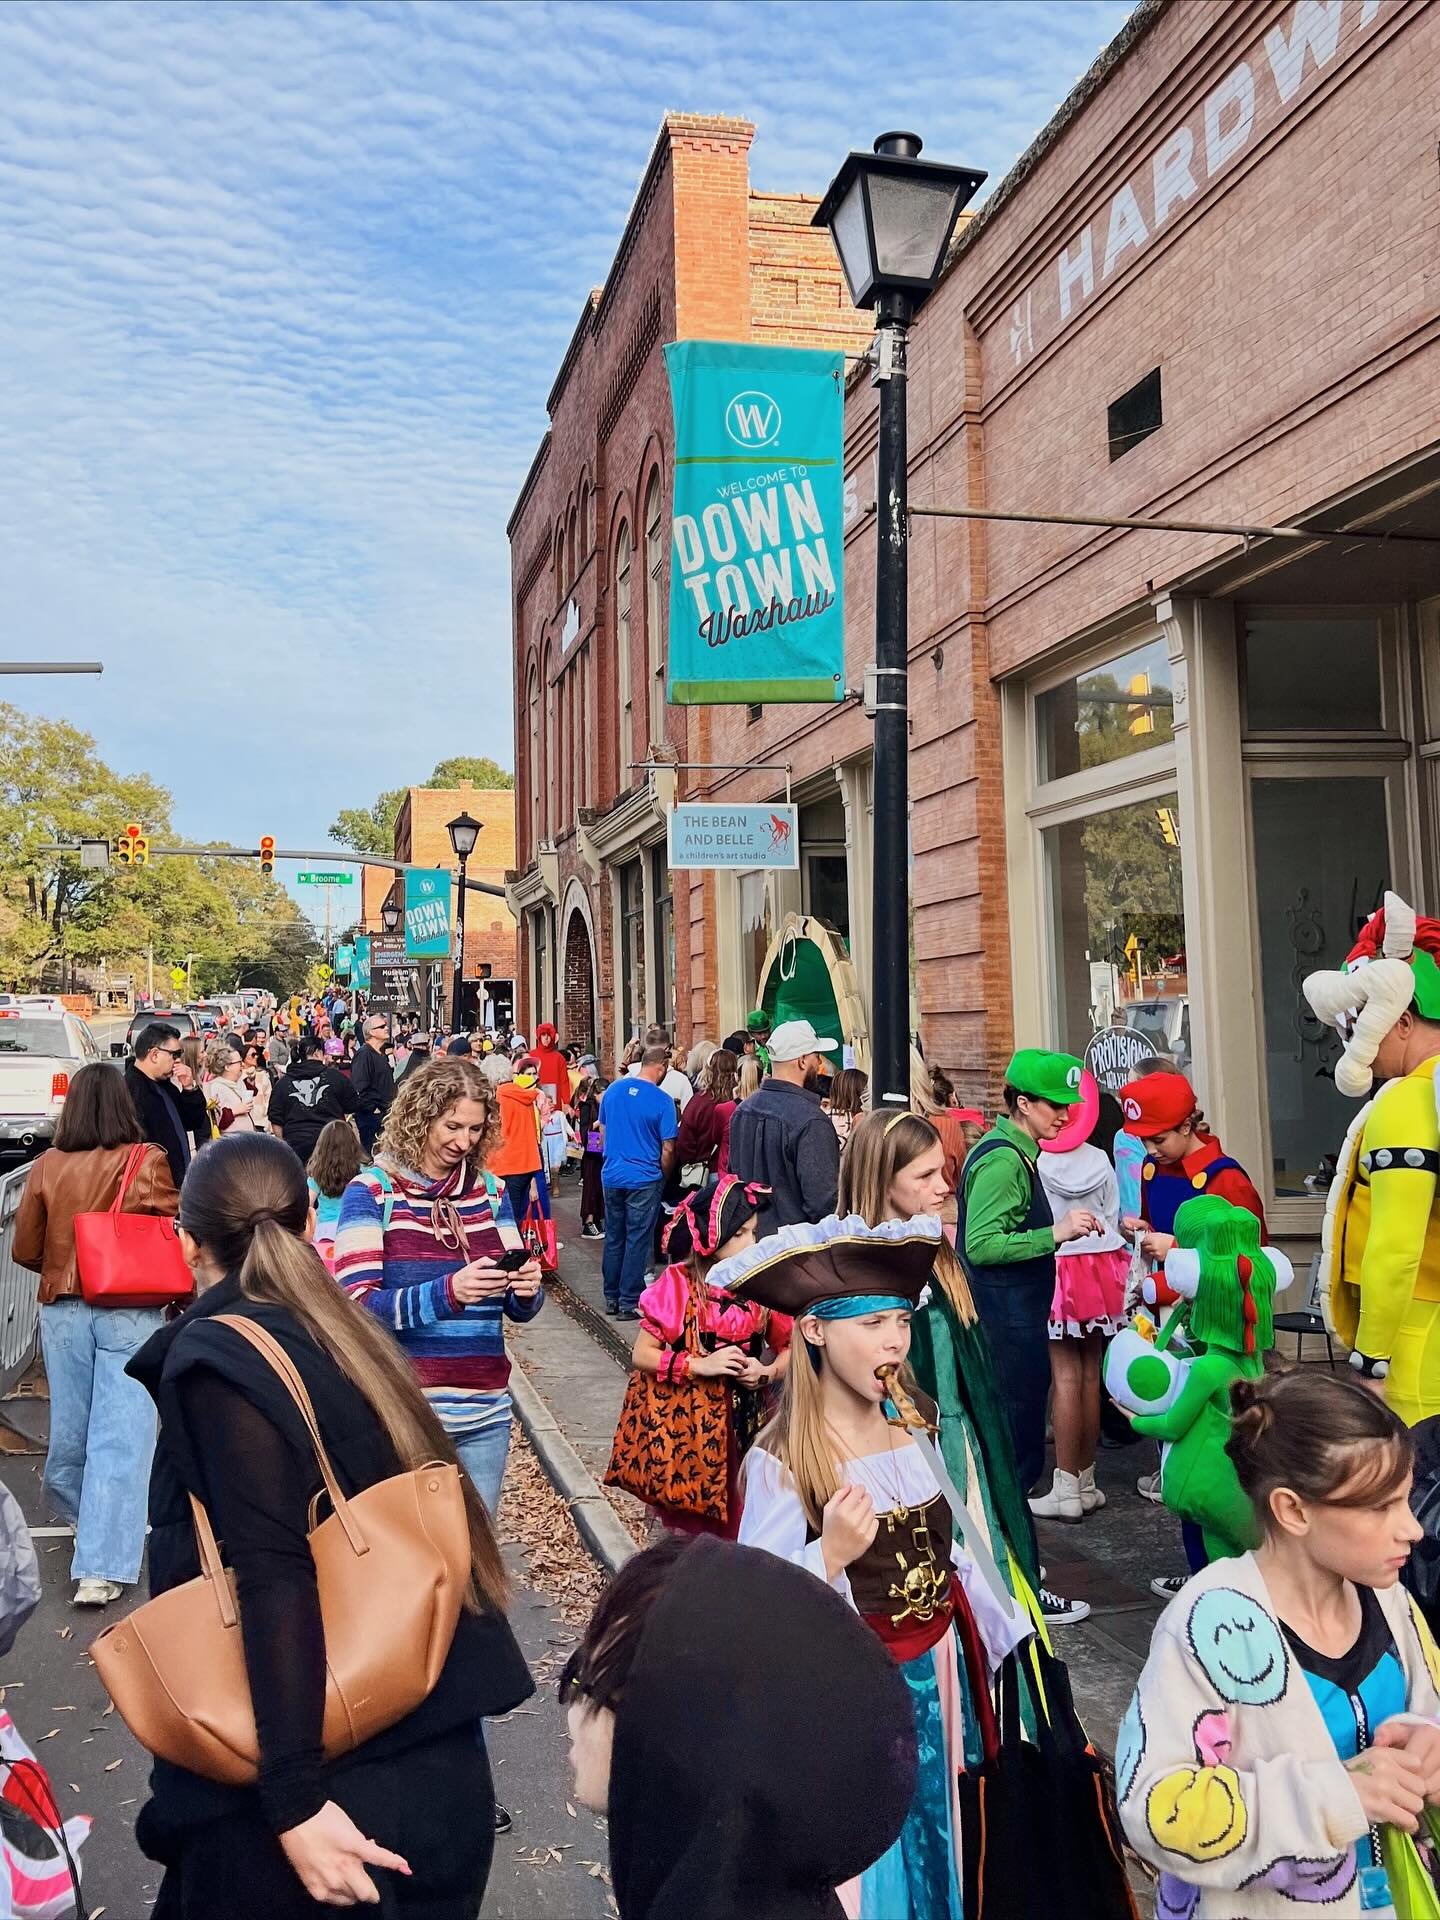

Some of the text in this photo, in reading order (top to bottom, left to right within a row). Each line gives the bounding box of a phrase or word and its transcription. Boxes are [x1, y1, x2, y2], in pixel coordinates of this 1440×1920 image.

[1058, 0, 1381, 320] HARDW
[716, 465, 808, 498] WELCOME TO
[673, 479, 824, 575] DOWN
[685, 538, 836, 627] TOWN
[699, 588, 835, 648] Waxhaw
[683, 816, 747, 827] THE BEAN
[684, 834, 754, 845] AND BELLE
[686, 852, 724, 860] children's
[310, 874, 340, 882] Broome
[406, 900, 446, 925] DOWN
[409, 916, 449, 940] TOWN
[1105, 1071, 1128, 1090] WAXH
[1126, 1102, 1139, 1116] M
